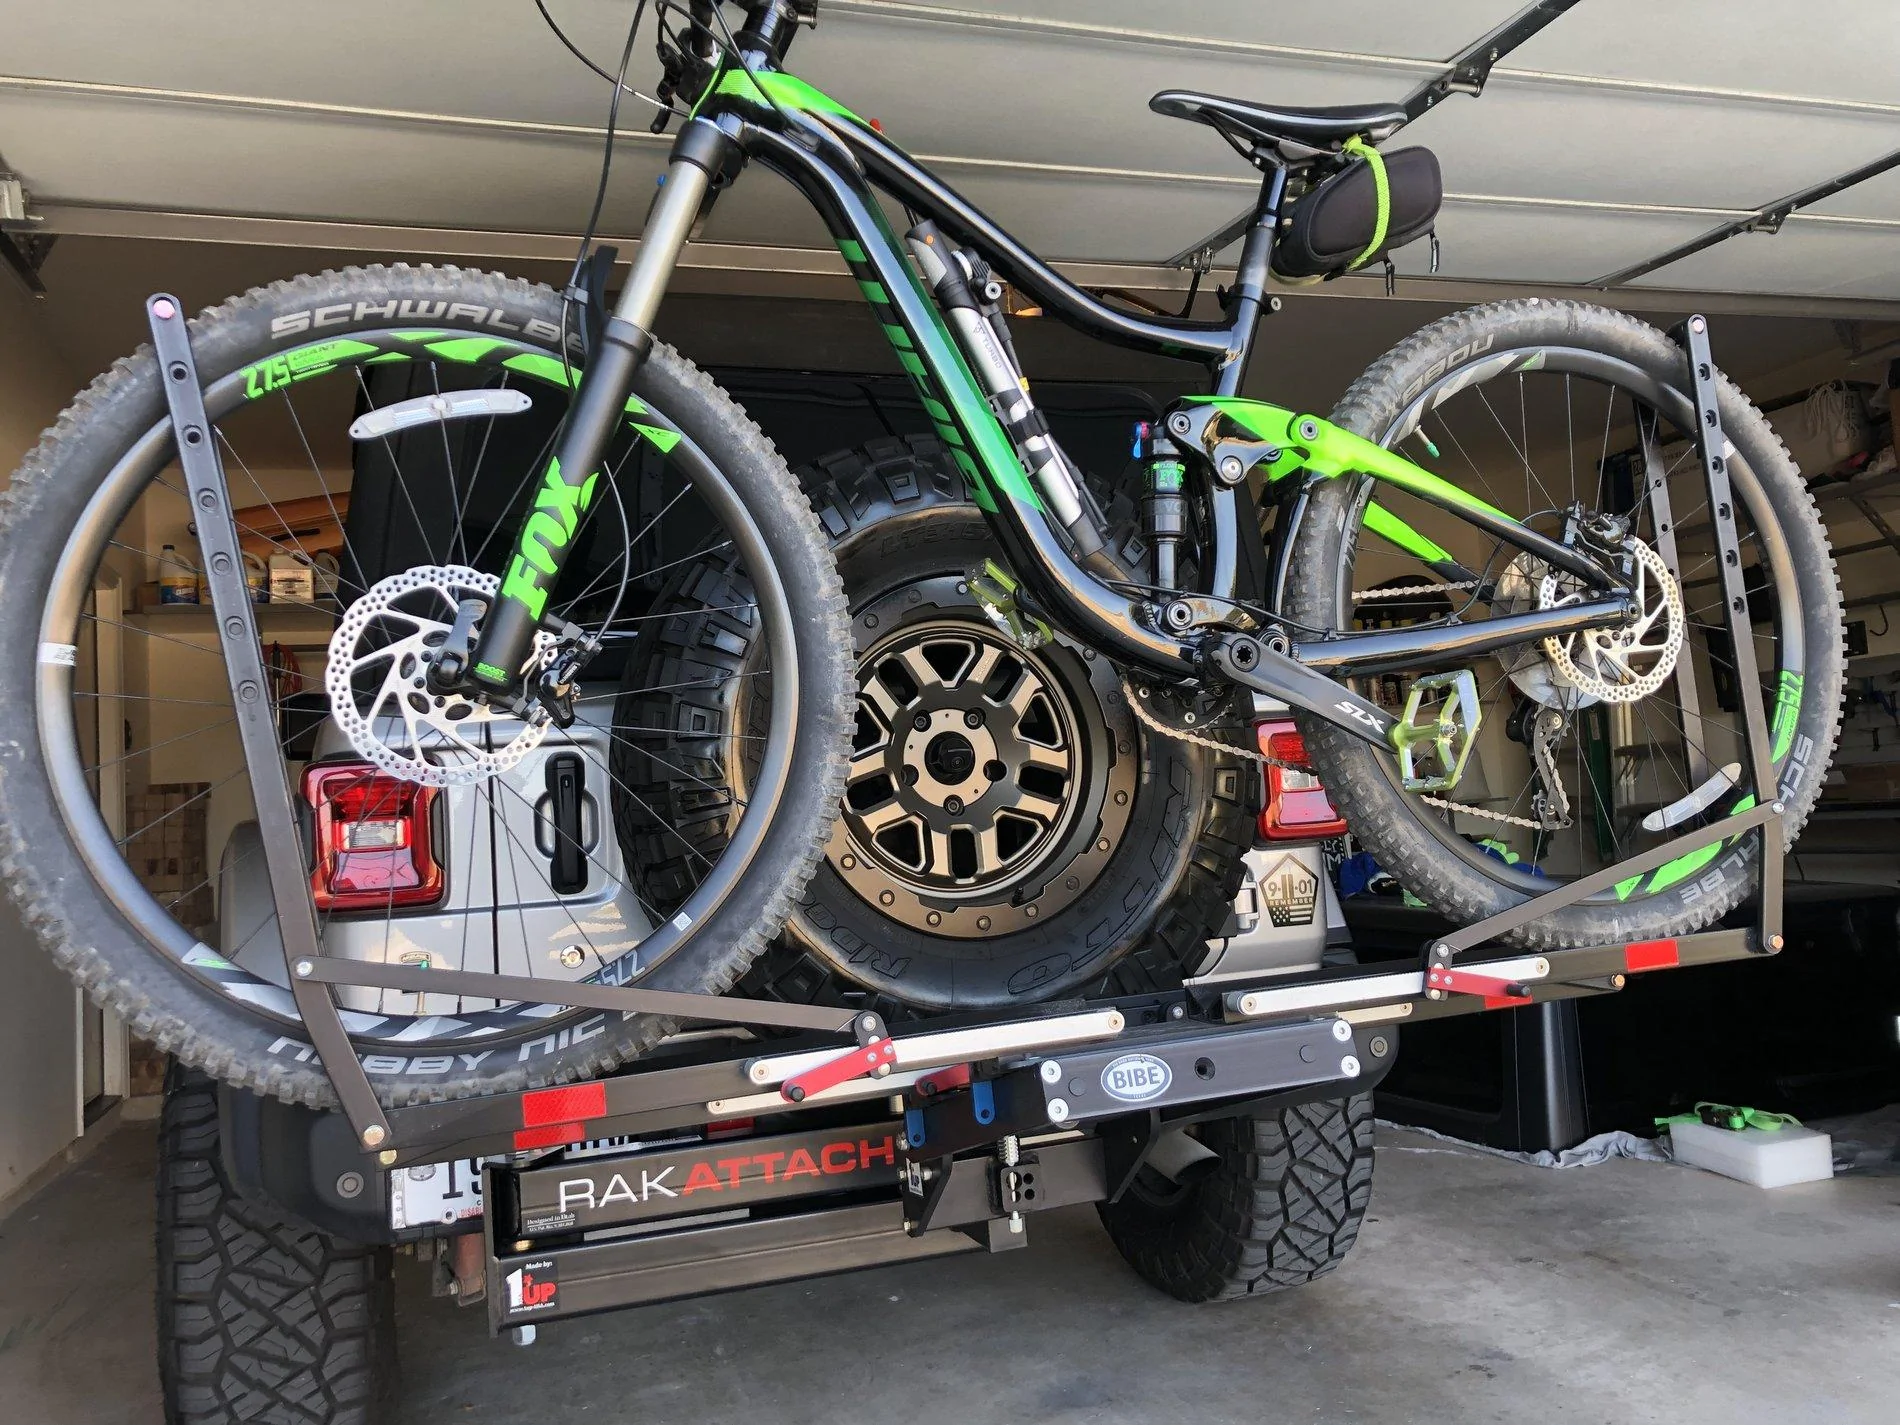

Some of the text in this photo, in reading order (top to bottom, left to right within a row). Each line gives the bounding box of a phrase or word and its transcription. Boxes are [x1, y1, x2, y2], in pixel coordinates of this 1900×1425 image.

[239, 354, 293, 400] 27.5
[502, 456, 599, 621] FOX
[1333, 701, 1385, 735] SLX
[1269, 897, 1314, 906] REMEMBER
[517, 1010, 606, 1062] NIC
[1112, 1065, 1161, 1090] BIBE
[525, 1261, 542, 1269] Made
